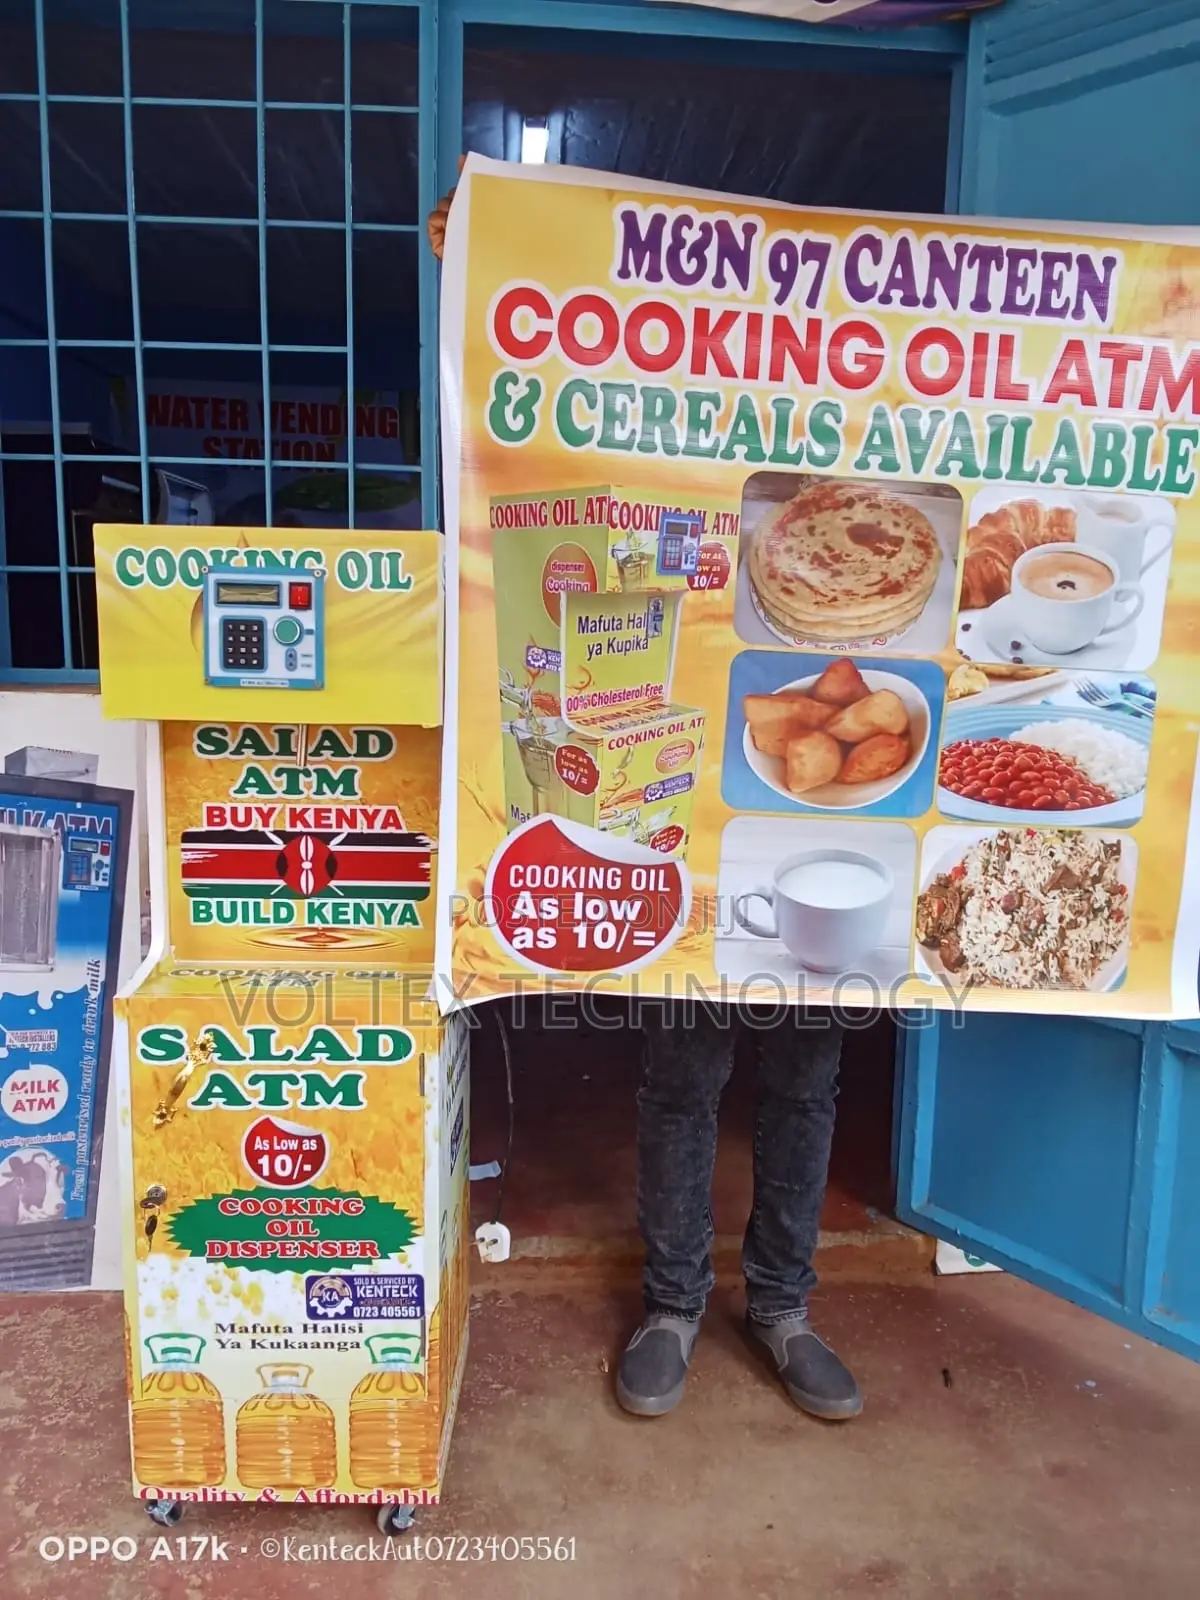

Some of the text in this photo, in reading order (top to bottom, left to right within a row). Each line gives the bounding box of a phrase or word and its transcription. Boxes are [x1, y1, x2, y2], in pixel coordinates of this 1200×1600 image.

[618, 209, 1118, 323] M&N 97 CANTEEN
[493, 287, 1200, 416] COOKING OIL ATM
[149, 394, 248, 431] WATER
[488, 371, 1199, 495] & CEREALS AVAILABLE
[490, 502, 548, 529] COOKING
[553, 499, 578, 526] OIL
[608, 500, 681, 531] COOKI
[712, 512, 740, 536] ATM
[338, 550, 412, 590] OIL
[577, 611, 648, 634] Mafuta Hal
[587, 635, 648, 661] ya Kupika
[591, 685, 643, 708] Cholesterol
[645, 683, 664, 697] Free
[196, 726, 394, 758] SALAD
[608, 727, 664, 751] COOKING
[667, 721, 686, 735] OIL
[233, 765, 359, 796] ATM
[205, 806, 402, 831] BUY KENYA
[510, 864, 671, 892] COOKING OIL
[191, 901, 420, 926] BUILD KENYA
[511, 890, 643, 922] As low
[511, 921, 657, 953] as 10/=
[140, 1027, 414, 1063] SALAD
[10, 1079, 61, 1094] MILK
[191, 1073, 365, 1108] ATM
[12, 1097, 56, 1113] ATM
[254, 1135, 317, 1151] As Low as
[257, 1153, 312, 1180] 10/-
[219, 1197, 365, 1216] COOKING
[266, 1219, 319, 1237] OIL
[206, 1240, 380, 1259] DISPENSER
[356, 1285, 418, 1298] KENTECK
[353, 1307, 421, 1318] 0723 405561
[214, 1322, 364, 1335] Mafuta Halisi
[216, 1338, 361, 1353] Ya Kukaanga
